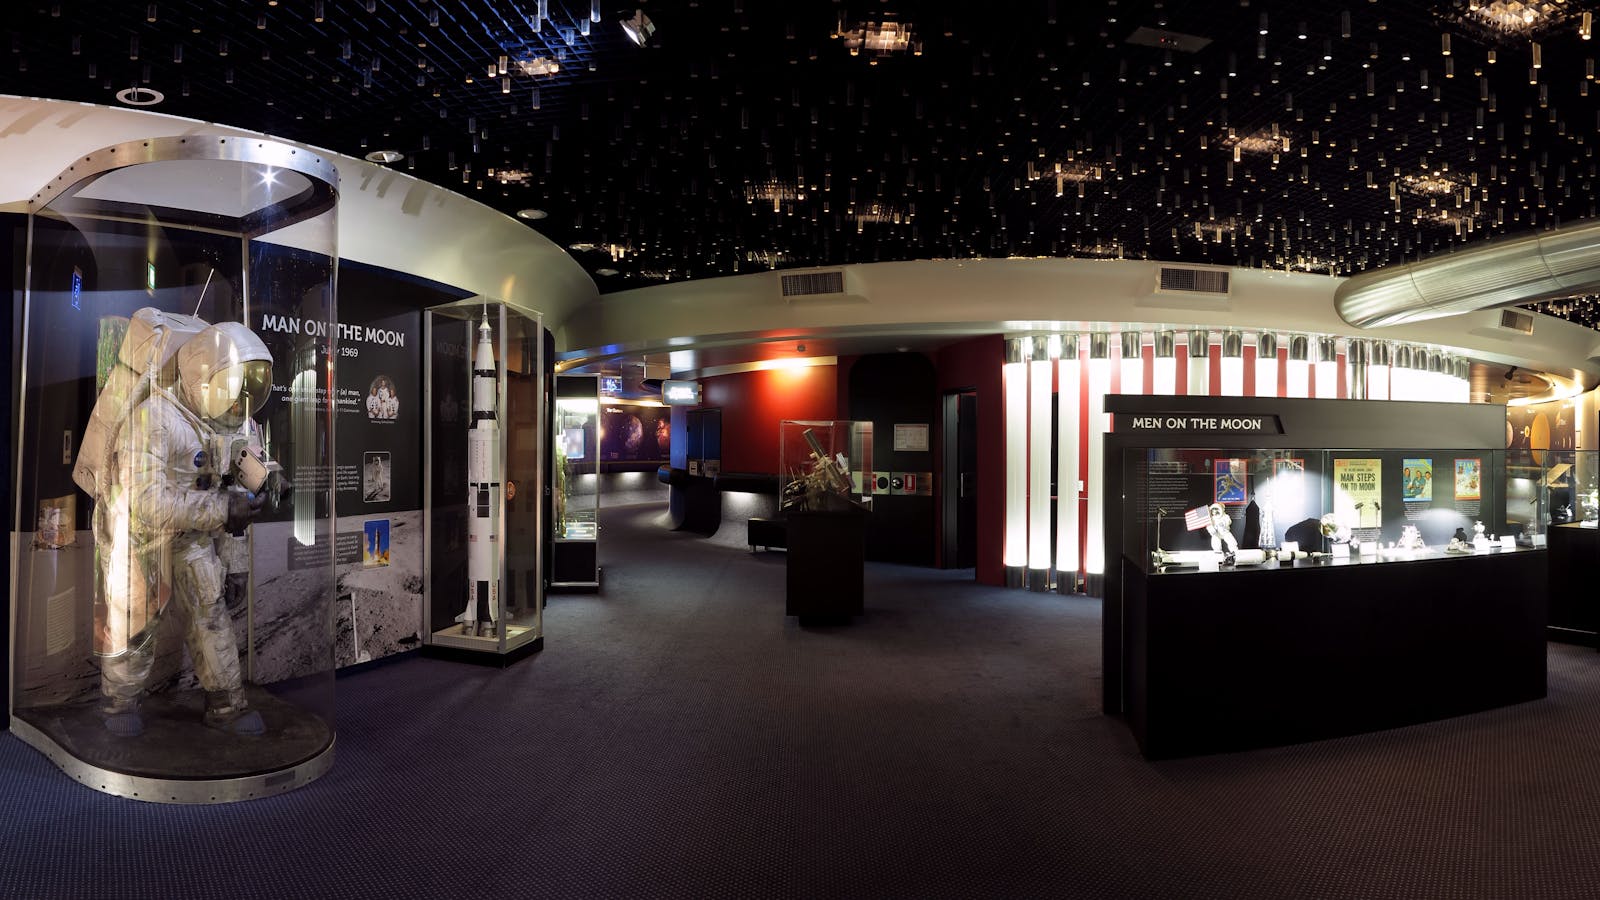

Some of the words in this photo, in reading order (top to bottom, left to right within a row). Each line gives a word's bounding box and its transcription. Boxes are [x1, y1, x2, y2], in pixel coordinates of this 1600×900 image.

[261, 314, 301, 334] MAN
[304, 319, 327, 337] ON
[330, 323, 363, 342] THE
[364, 327, 405, 347] MOON
[320, 344, 340, 356] Ju
[341, 347, 359, 358] 1969
[1132, 417, 1162, 428] MEN
[1166, 418, 1187, 429] ON
[1191, 418, 1217, 430] THE
[1220, 419, 1262, 430] MOON
[1340, 473, 1354, 482] MAN
[1357, 472, 1376, 482] STEPS
[1340, 482, 1348, 491] ON
[1350, 482, 1357, 491] TO
[1359, 482, 1376, 491] MOON
